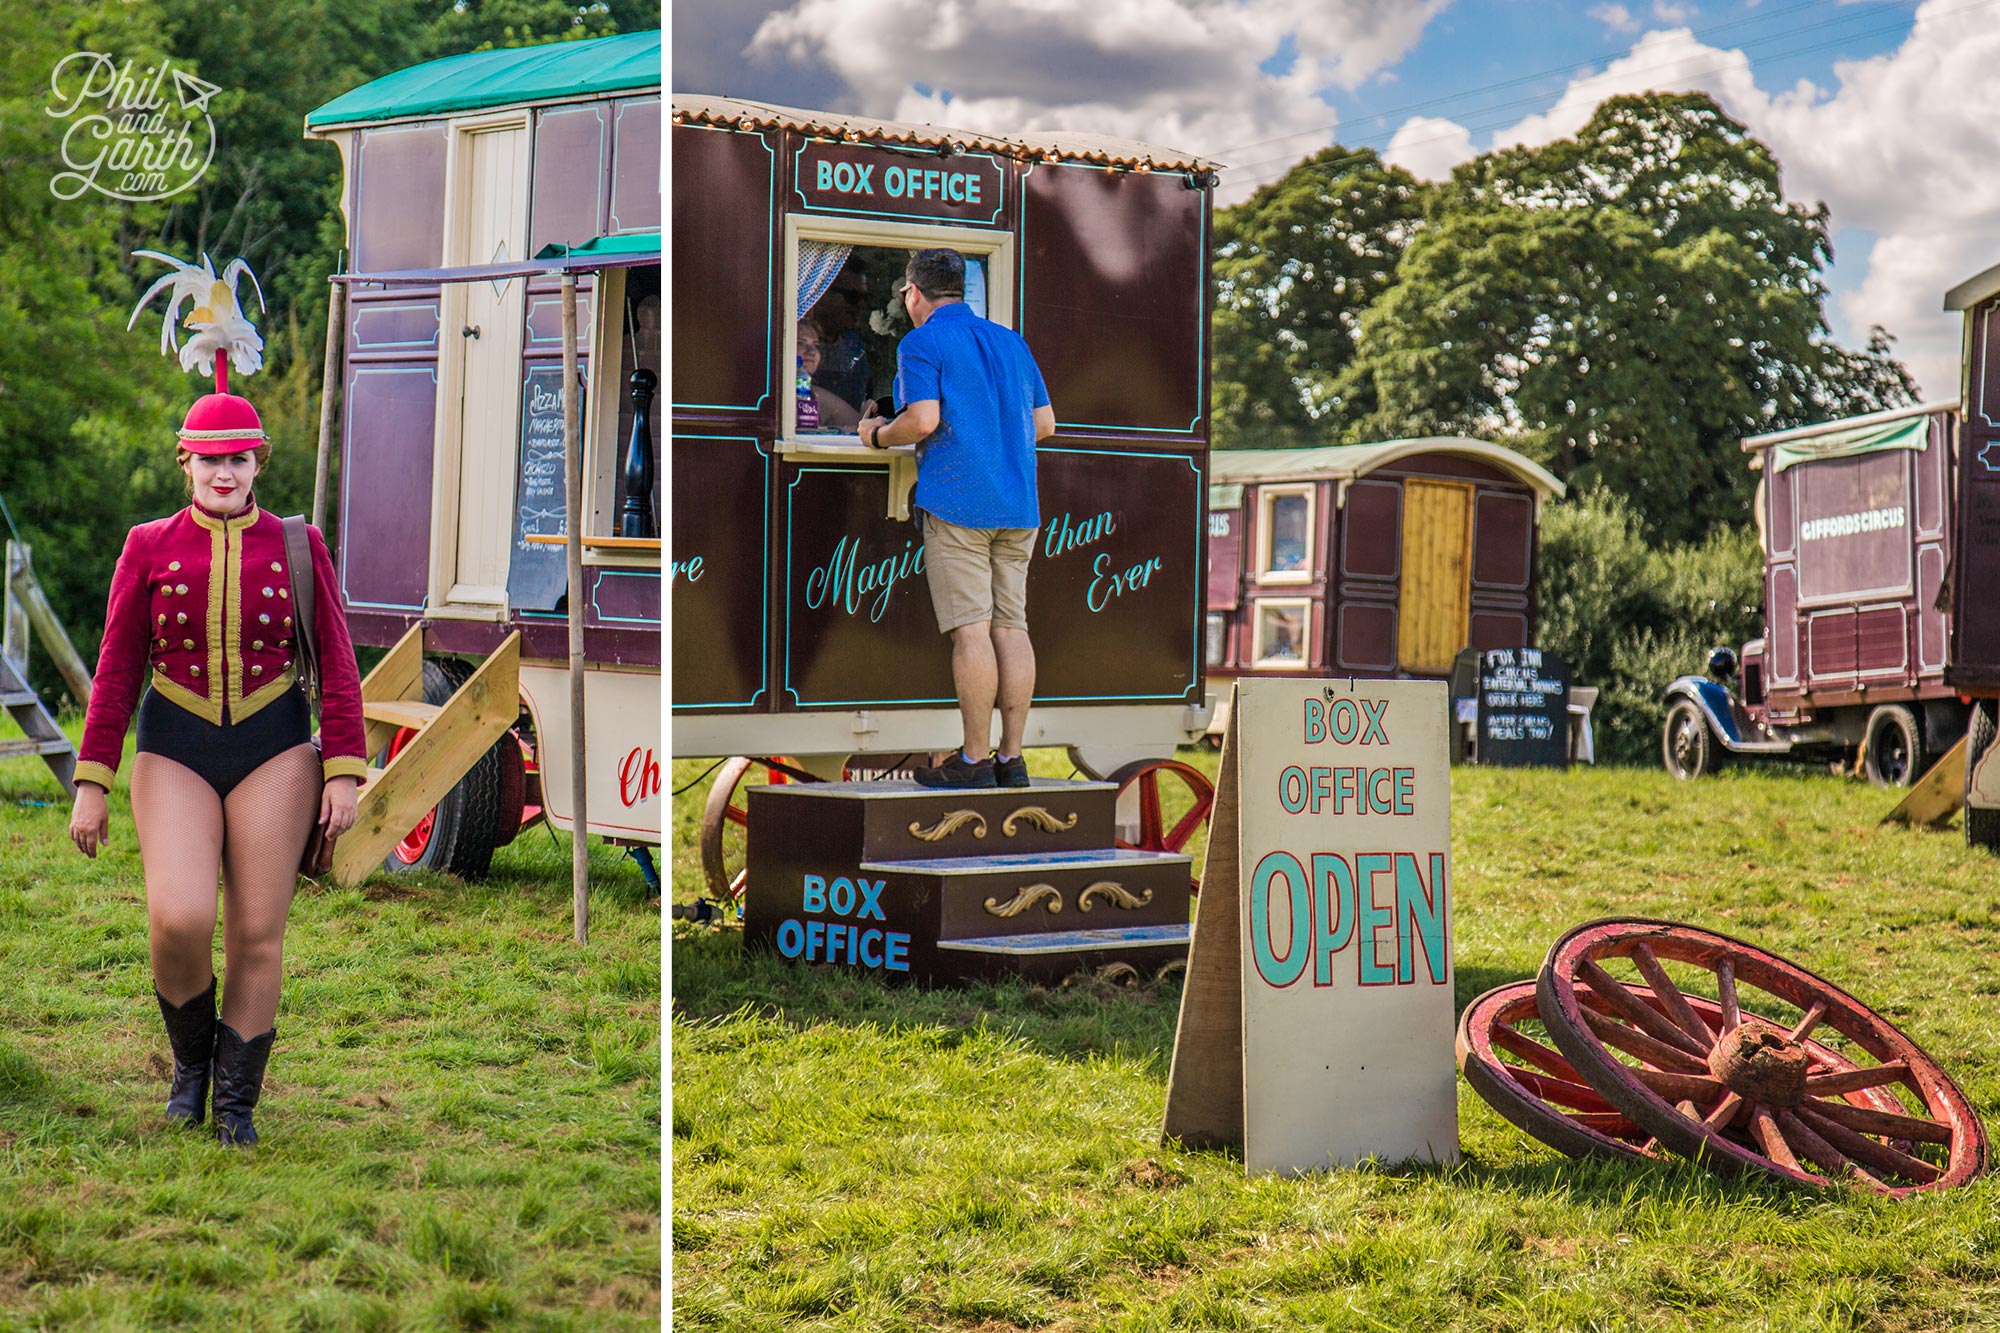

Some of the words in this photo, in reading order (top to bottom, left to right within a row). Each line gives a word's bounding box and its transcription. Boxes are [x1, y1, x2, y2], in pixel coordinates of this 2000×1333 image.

[817, 159, 875, 195] BOX
[884, 165, 981, 204] OFFICE
[1045, 511, 1116, 558] than
[1801, 512, 1861, 541] GIFFORDS
[1860, 506, 1905, 533] CIRCUS
[1087, 552, 1162, 613] Ever
[1487, 648, 1515, 669] FOX
[1304, 698, 1390, 745] BOX
[1279, 765, 1415, 816] OFFICE
[803, 874, 887, 921] BOX
[1250, 850, 1448, 989] OPEN
[776, 918, 911, 972] OFFICE
